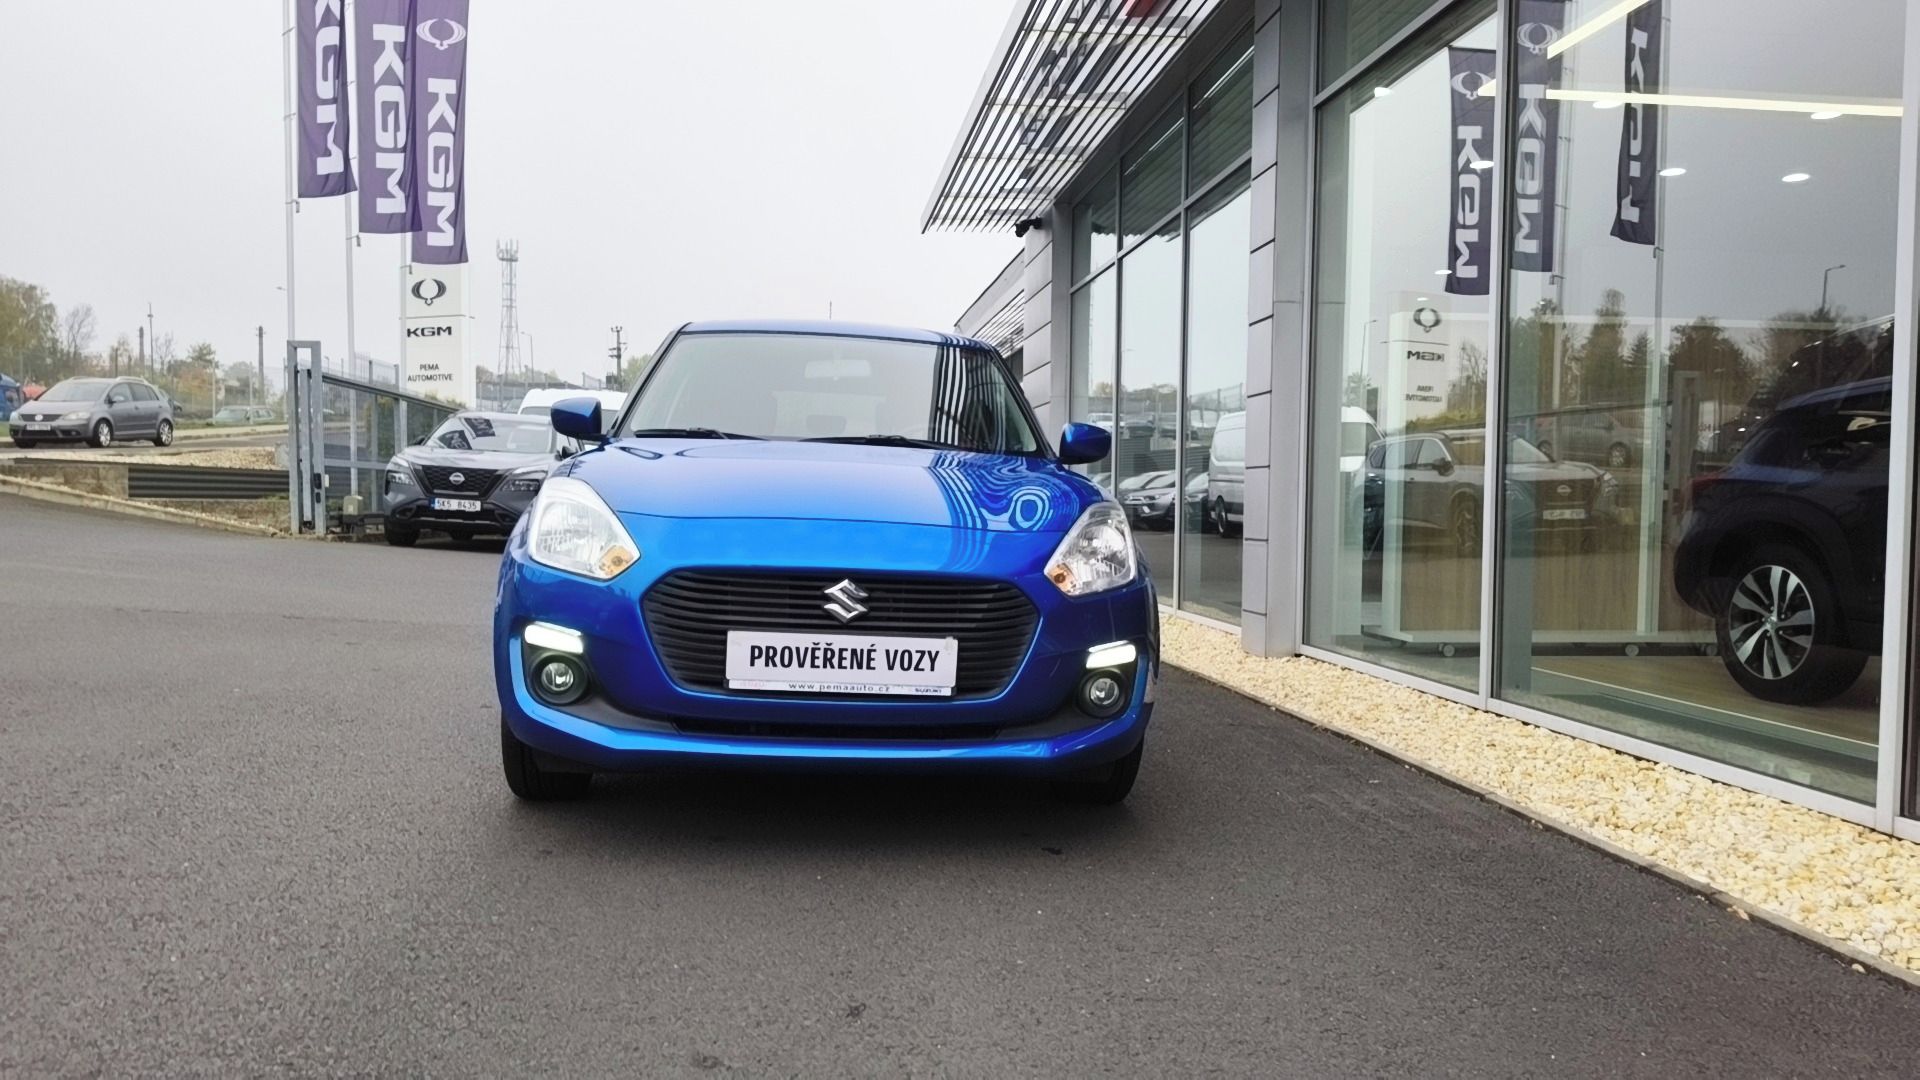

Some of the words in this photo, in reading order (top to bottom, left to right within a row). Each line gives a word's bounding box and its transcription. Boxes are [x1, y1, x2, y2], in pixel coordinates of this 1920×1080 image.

[372, 23, 406, 214] KGM
[426, 78, 456, 246] KGM
[407, 326, 452, 338] KGM
[419, 363, 440, 371] PEMA
[407, 373, 453, 382] AUTOMOTIVE
[749, 642, 877, 671] PROVĚŘENÉ
[885, 648, 940, 672] VOZY
[788, 682, 890, 693] www.pemaauto.cz
